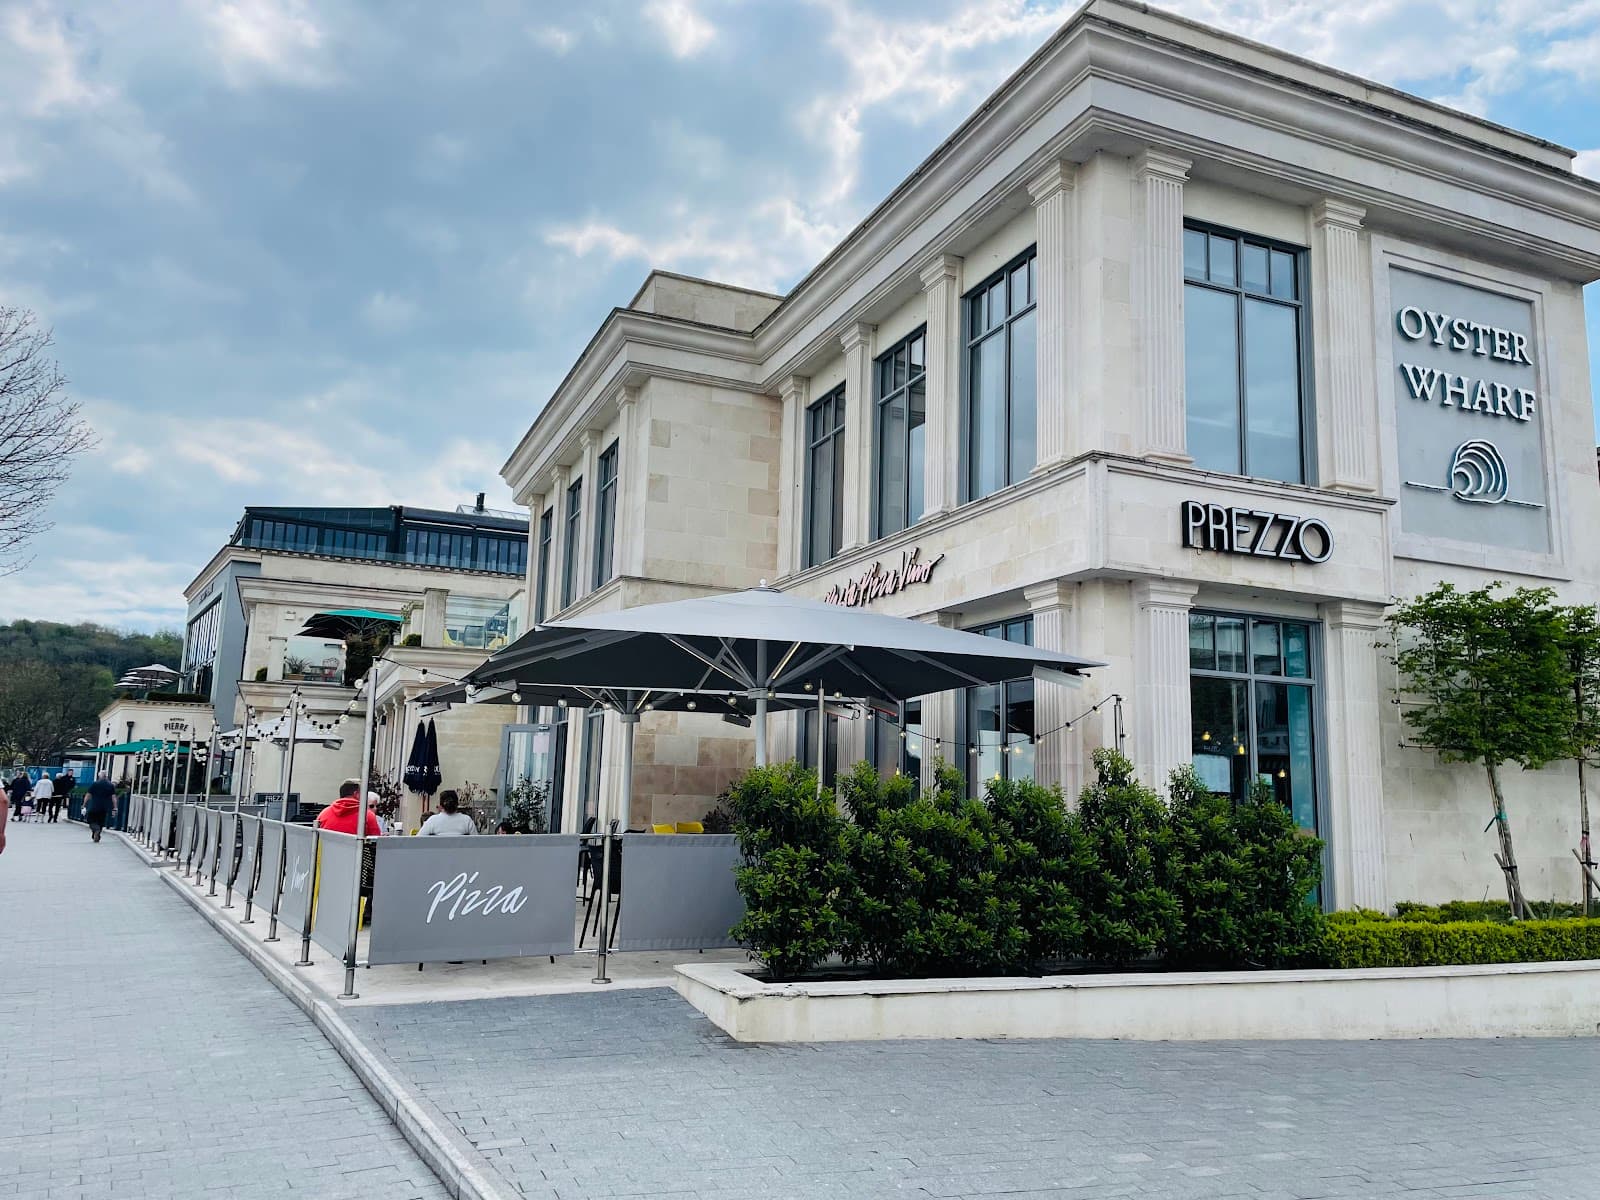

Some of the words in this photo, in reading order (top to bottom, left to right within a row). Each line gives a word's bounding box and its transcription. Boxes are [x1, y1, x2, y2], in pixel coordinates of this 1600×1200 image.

[1397, 305, 1533, 365] OYSTER
[1401, 362, 1536, 422] WHARF
[1182, 500, 1335, 564] PREZZO
[164, 722, 189, 732] PIERRE
[426, 871, 528, 924] Pizza
